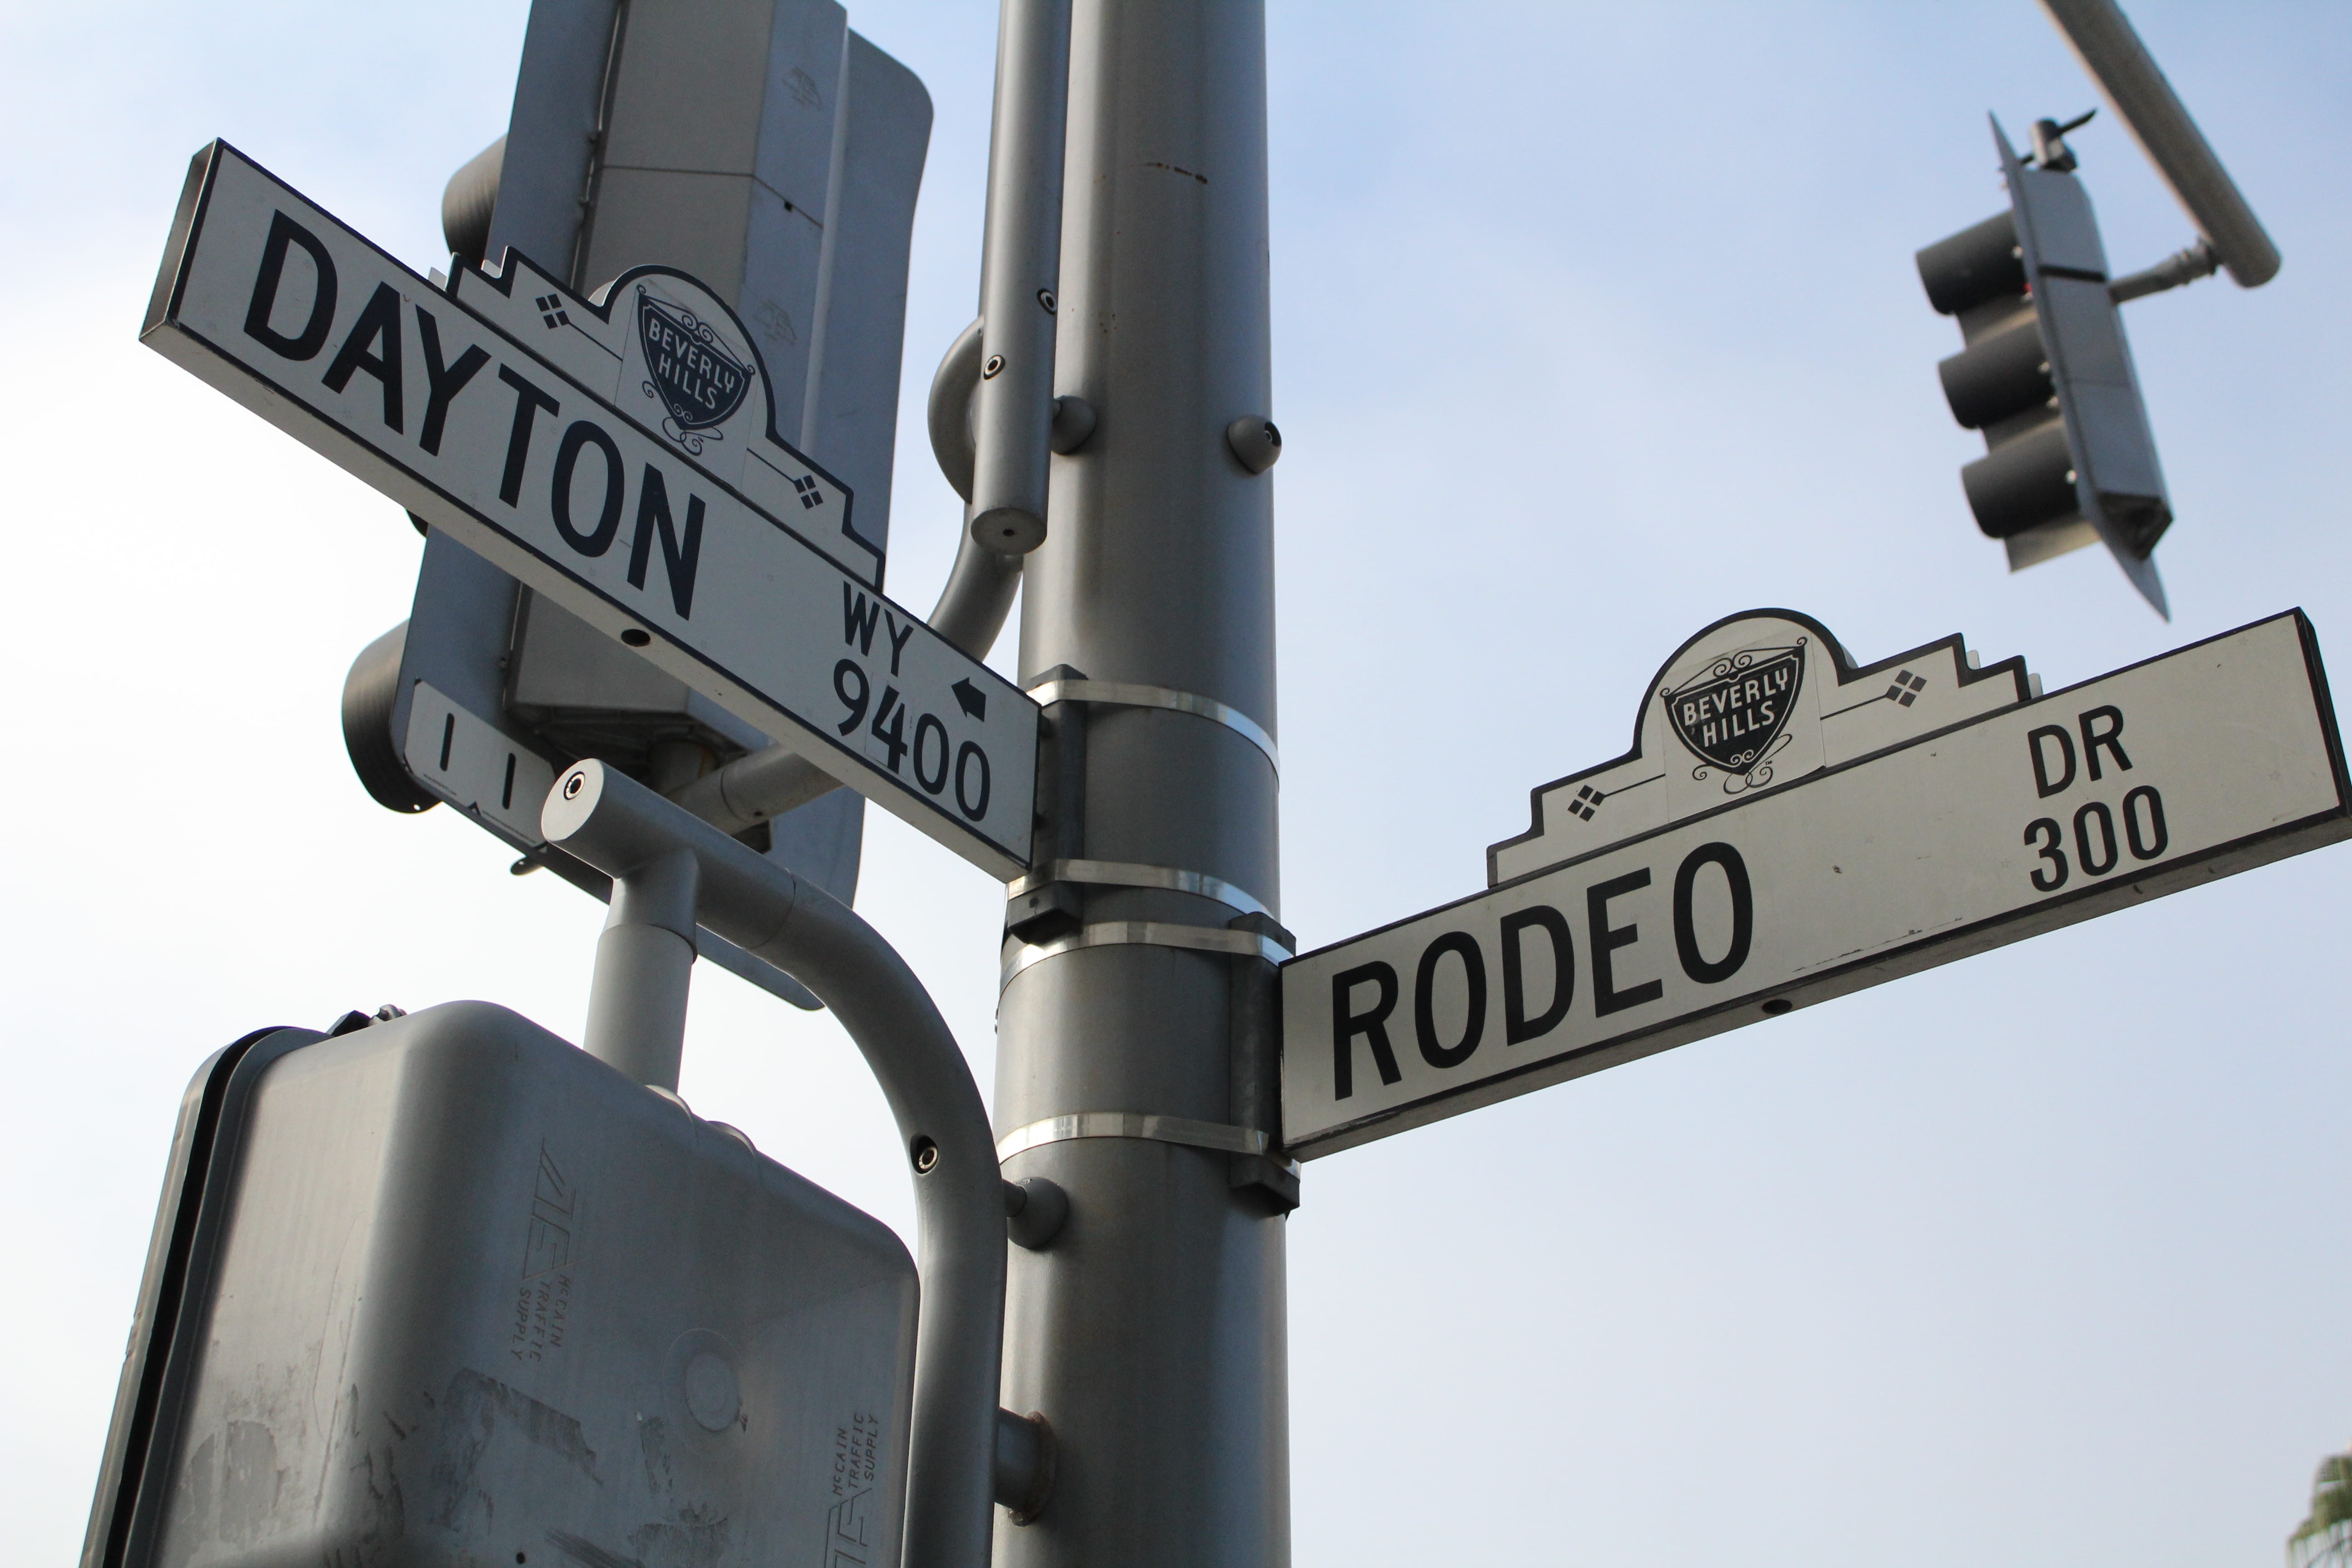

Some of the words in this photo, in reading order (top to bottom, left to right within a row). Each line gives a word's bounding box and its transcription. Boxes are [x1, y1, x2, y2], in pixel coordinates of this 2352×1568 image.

[649, 318, 735, 393] BEVERLY
[658, 353, 717, 409] HILLS
[244, 209, 706, 620] DAYTON
[843, 581, 914, 676] WY
[1683, 667, 1788, 726] BEVERLY
[1703, 701, 1775, 747] HILLS
[833, 659, 990, 822] 9400
[2028, 705, 2132, 799] DR
[2024, 785, 2169, 892] 300
[1332, 842, 1753, 1101] RODEO
[511, 1287, 531, 1360] SUPPLY
[529, 1281, 550, 1362] TRAFFIC
[848, 1412, 864, 1489] TRAFFIC
[864, 1414, 879, 1481] SUPPLY
